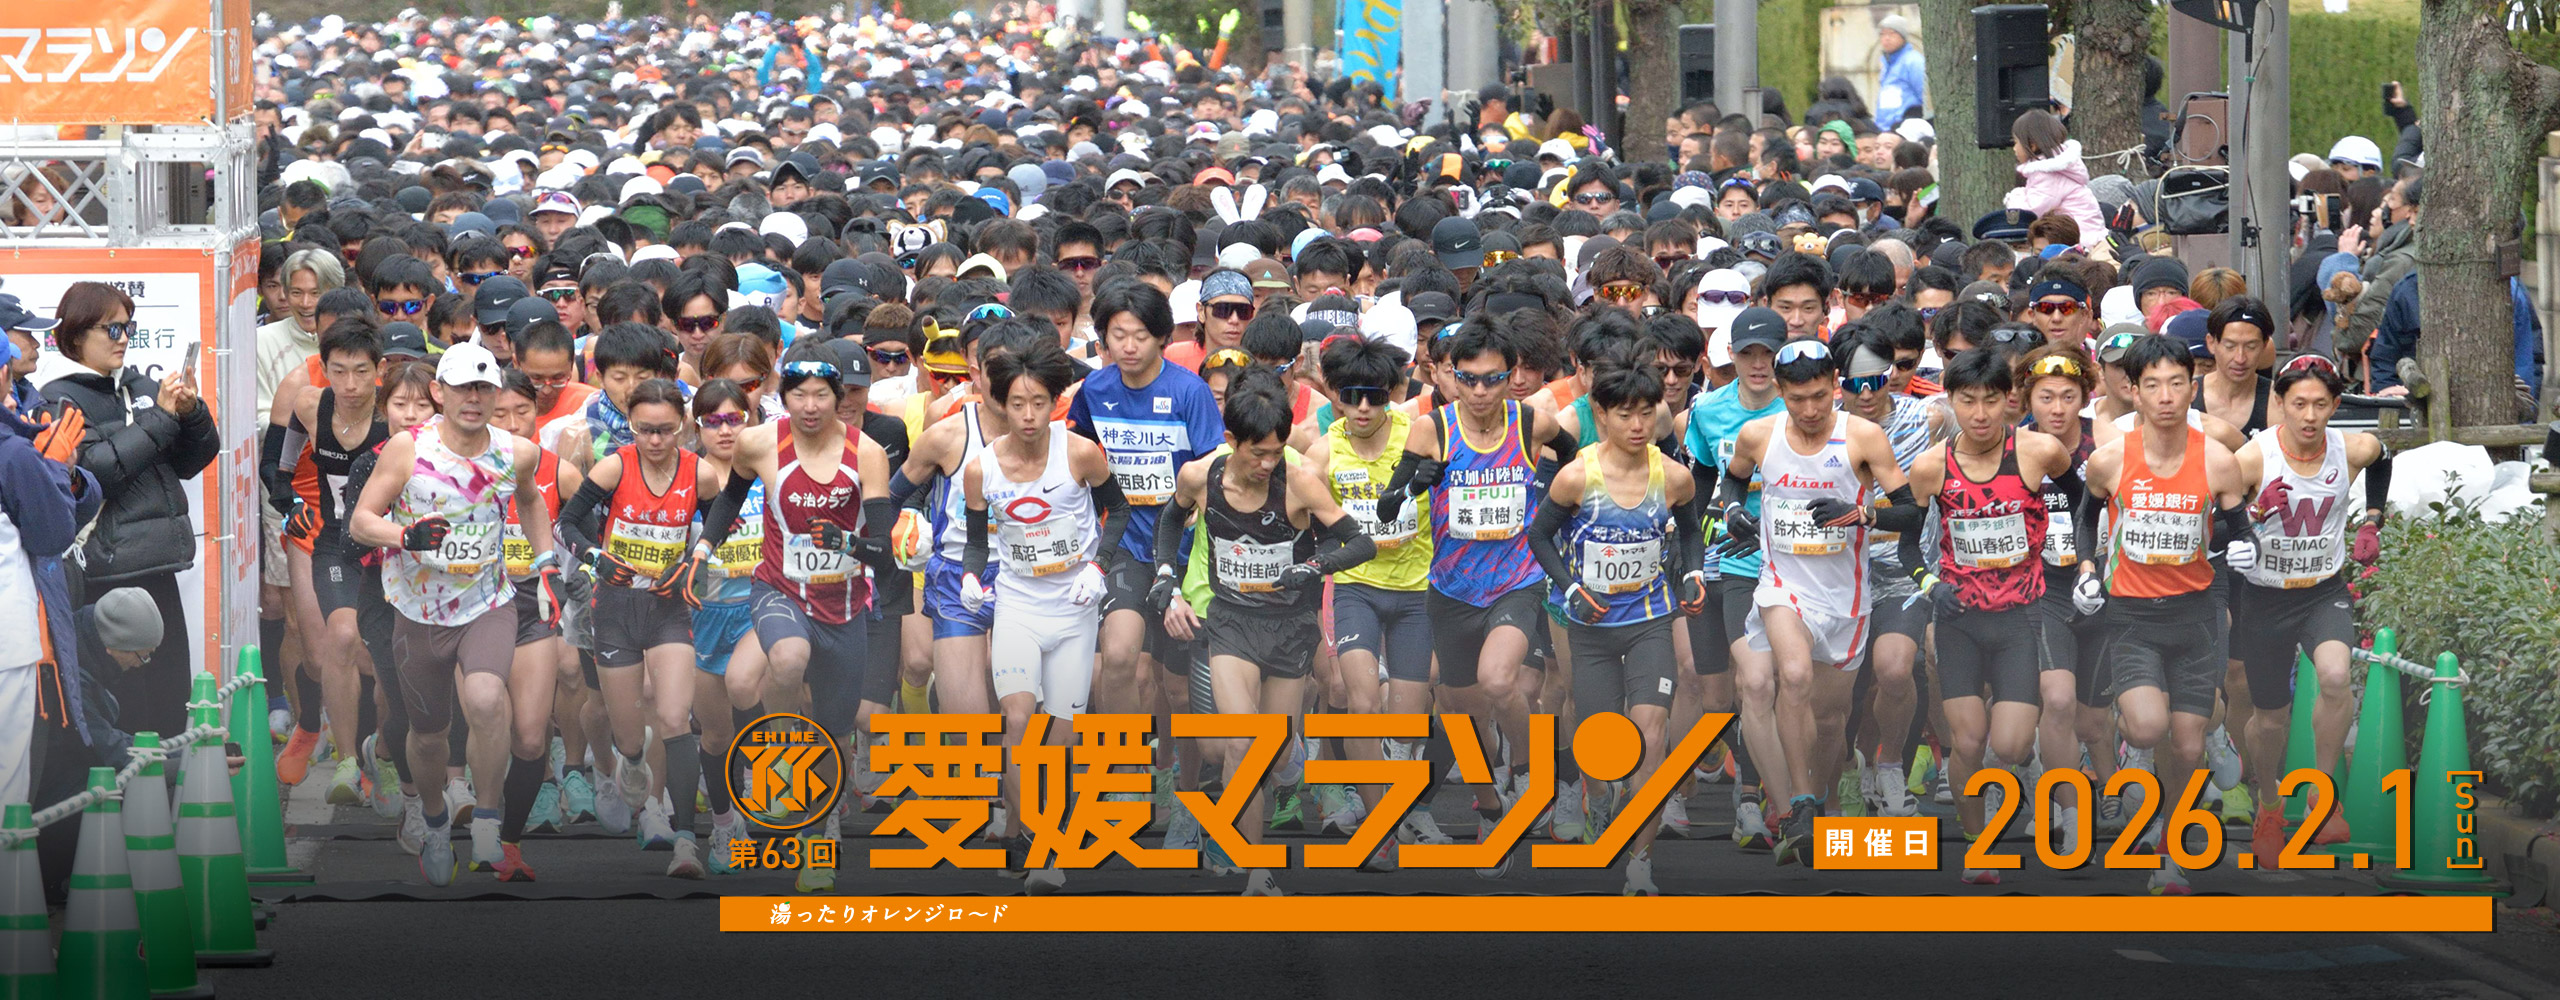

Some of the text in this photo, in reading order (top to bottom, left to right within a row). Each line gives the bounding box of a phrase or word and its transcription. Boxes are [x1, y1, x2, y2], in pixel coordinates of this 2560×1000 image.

[0, 27, 198, 83] マラソン
[129, 328, 175, 349] 銀行
[1102, 426, 1175, 447] 神奈川大
[1114, 472, 1173, 492] 西良介 S
[1775, 472, 1836, 489] Aisan
[787, 491, 853, 510] 今治クラブ
[1479, 486, 1516, 501] FUJI
[2131, 492, 2198, 511] 愛媛銀行
[1407, 519, 1417, 531] S
[1457, 506, 1525, 526] 森 貴樹 S
[1967, 518, 2017, 532] 伊予銀行
[2279, 496, 2336, 537] W
[1025, 528, 1051, 539] meiji
[1773, 518, 1846, 540] 鈴木洋平 S
[489, 543, 498, 557] S
[1070, 538, 1080, 554] S
[1954, 535, 2027, 556] 岡山春紀 S
[2125, 529, 2200, 551] 中村佳樹 S
[2271, 537, 2329, 552] BEMAC
[501, 543, 536, 561] 美空
[714, 542, 763, 565] 藤優花
[1248, 547, 1276, 556] ヤマキ
[1620, 546, 1648, 556] ヤマキ
[793, 551, 844, 572] 1027
[1220, 557, 1280, 580] 武村佳尚
[1594, 560, 1658, 582] 1002 S
[2264, 554, 2334, 575] 日野斗馬 S
